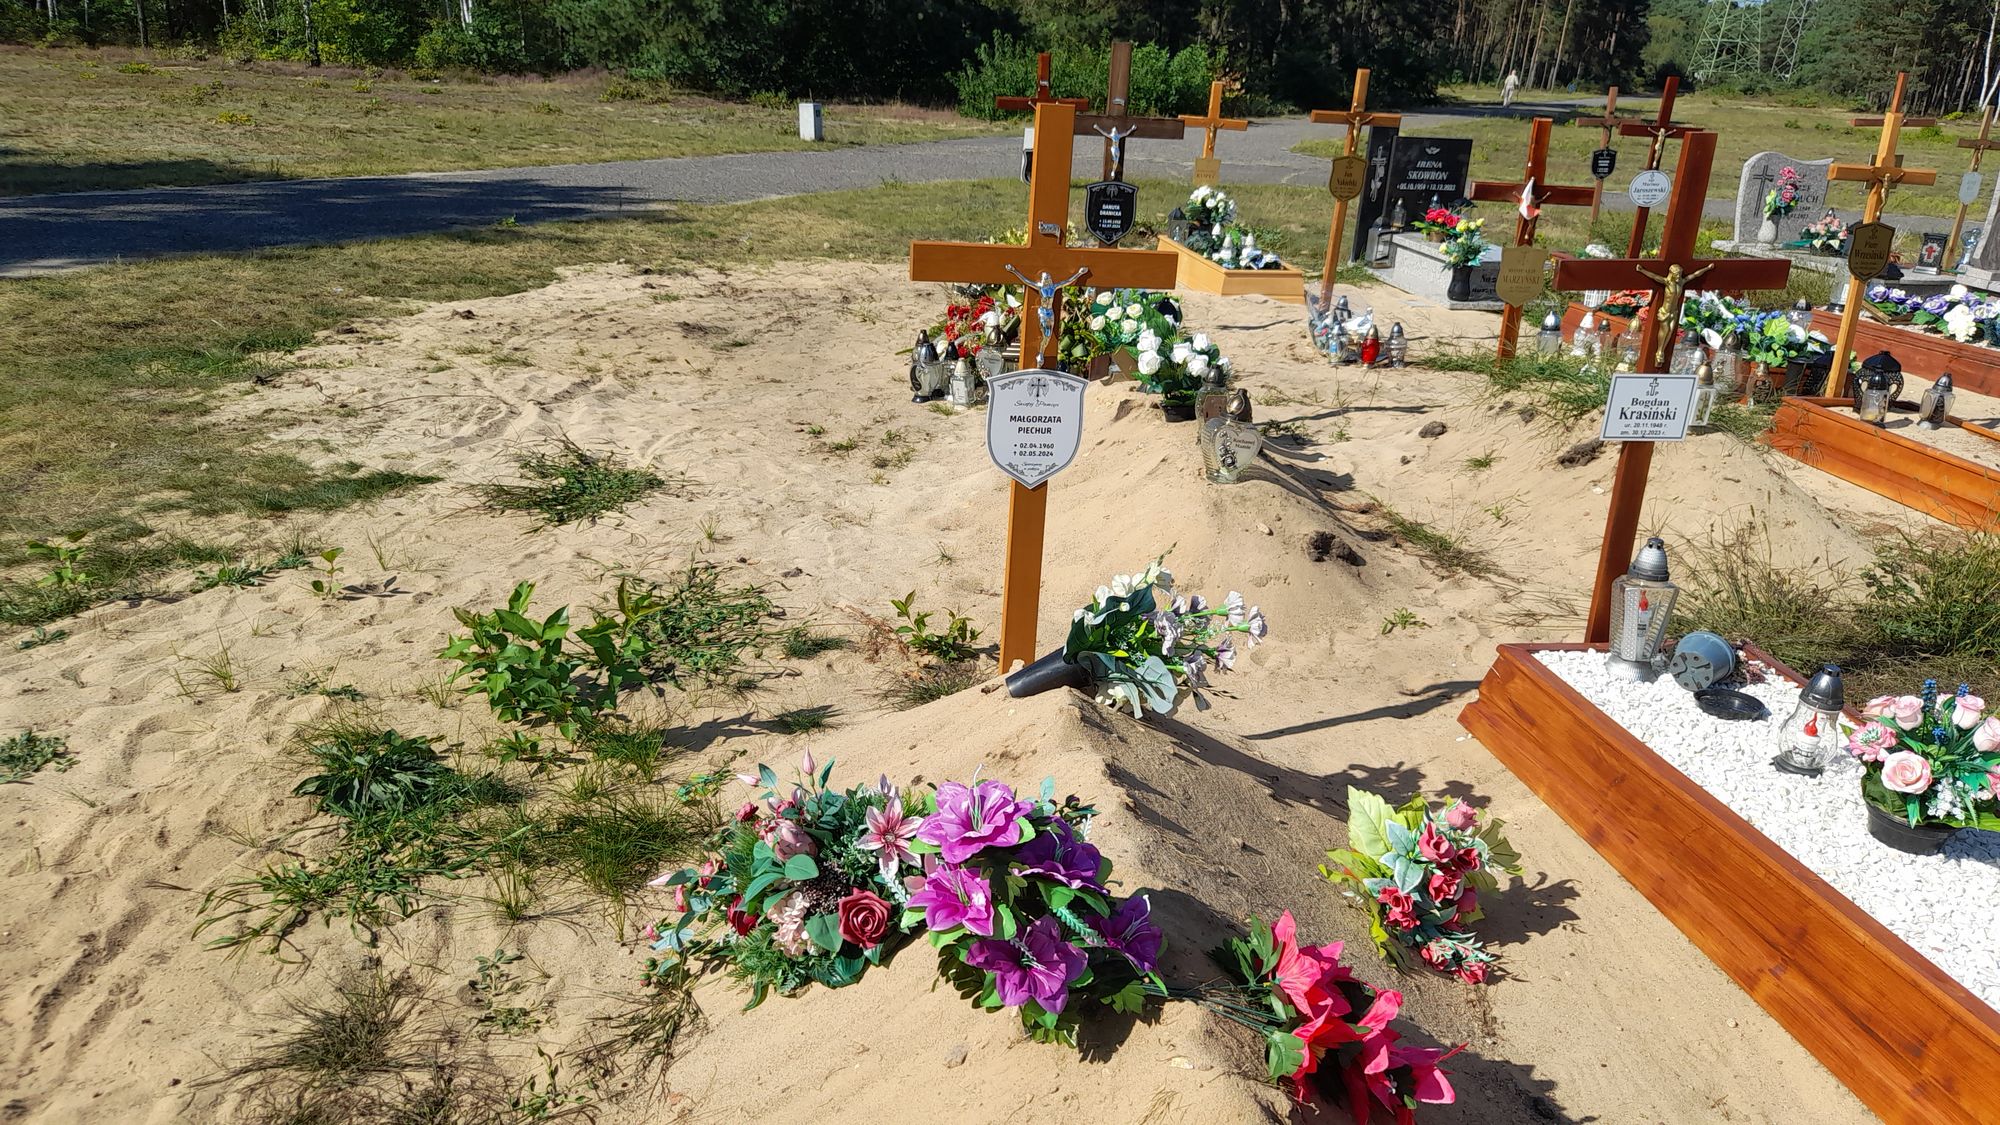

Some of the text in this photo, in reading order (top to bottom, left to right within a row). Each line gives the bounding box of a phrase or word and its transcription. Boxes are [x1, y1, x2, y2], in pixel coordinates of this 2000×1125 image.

[1416, 160, 1443, 168] IRENA
[1406, 170, 1449, 180] SKOWRON
[1631, 397, 1670, 408] Bogdan
[1619, 406, 1678, 420] Krasiński
[1009, 415, 1062, 424] MAŁGORZATA
[1017, 426, 1052, 435] PIECHUR
